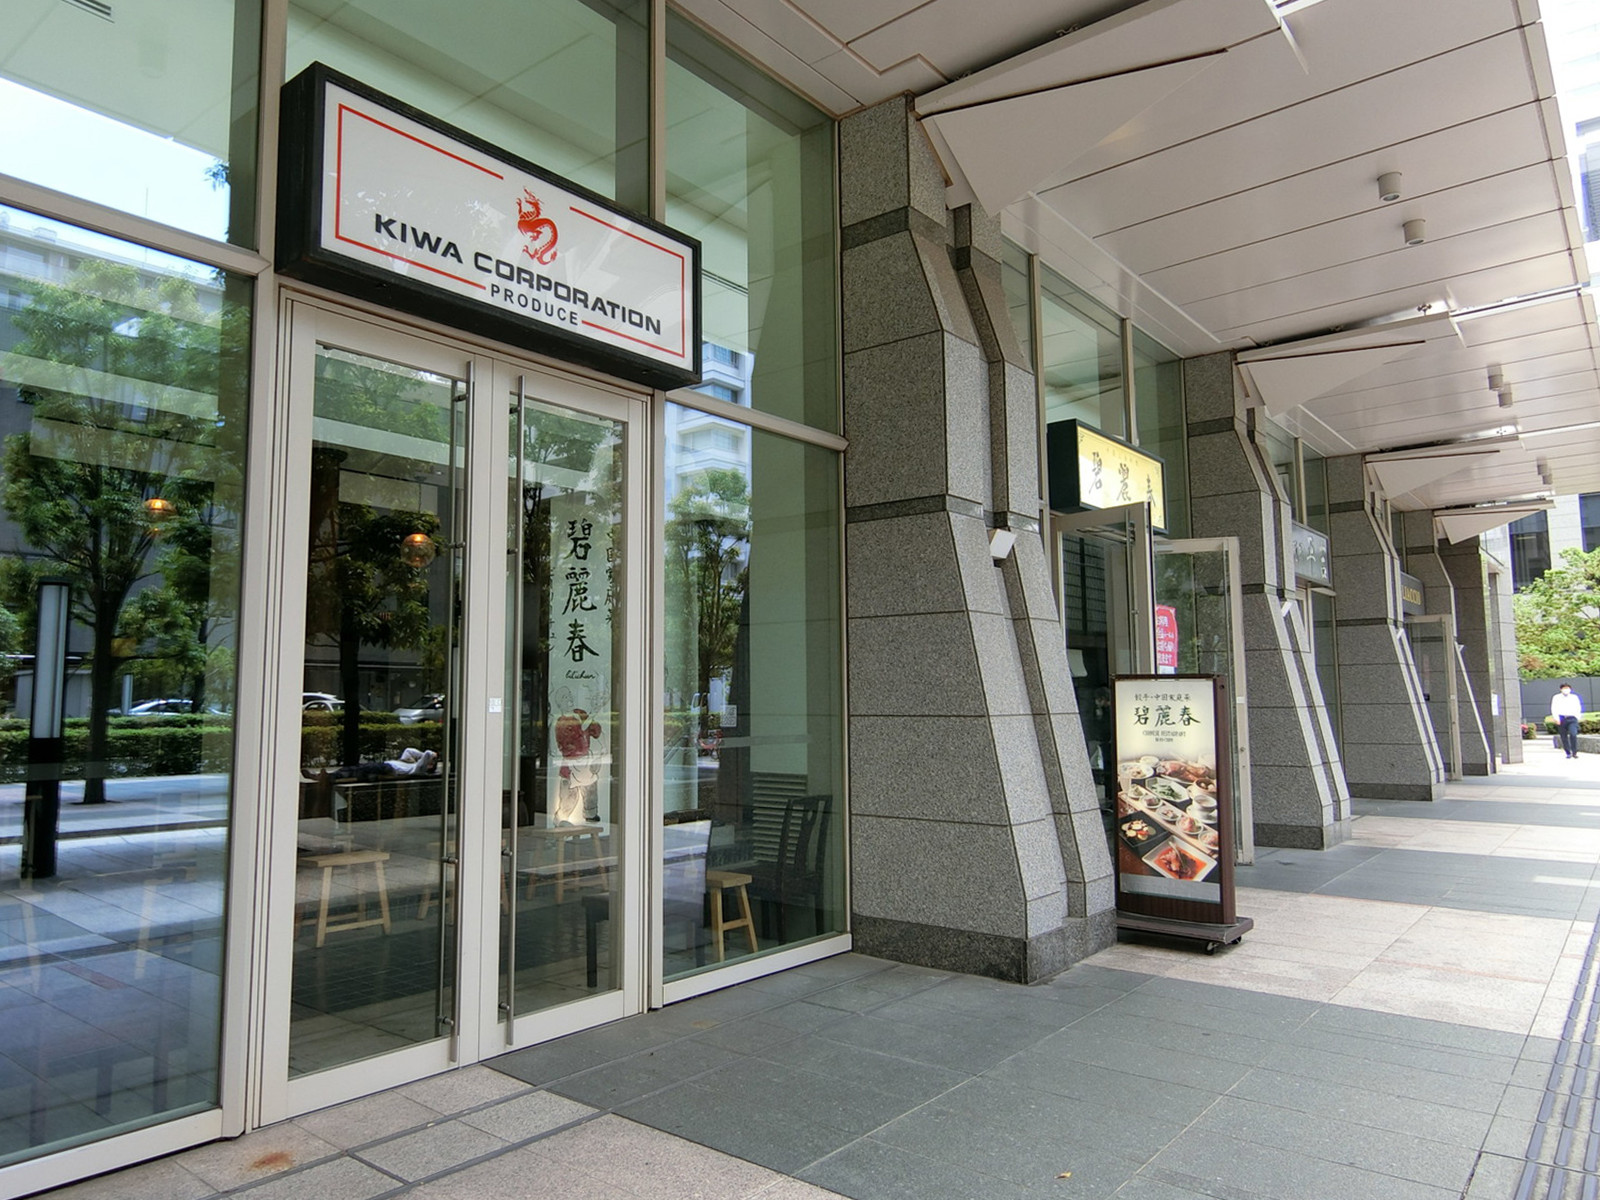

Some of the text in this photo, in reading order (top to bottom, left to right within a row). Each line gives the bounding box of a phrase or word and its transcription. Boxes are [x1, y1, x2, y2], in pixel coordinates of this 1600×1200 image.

[375, 213, 661, 335] KIWA CORPORATION
[491, 284, 579, 325] PRODUCE
[562, 518, 600, 662] 碧麗春
[1134, 705, 1201, 727] 碧麗春
